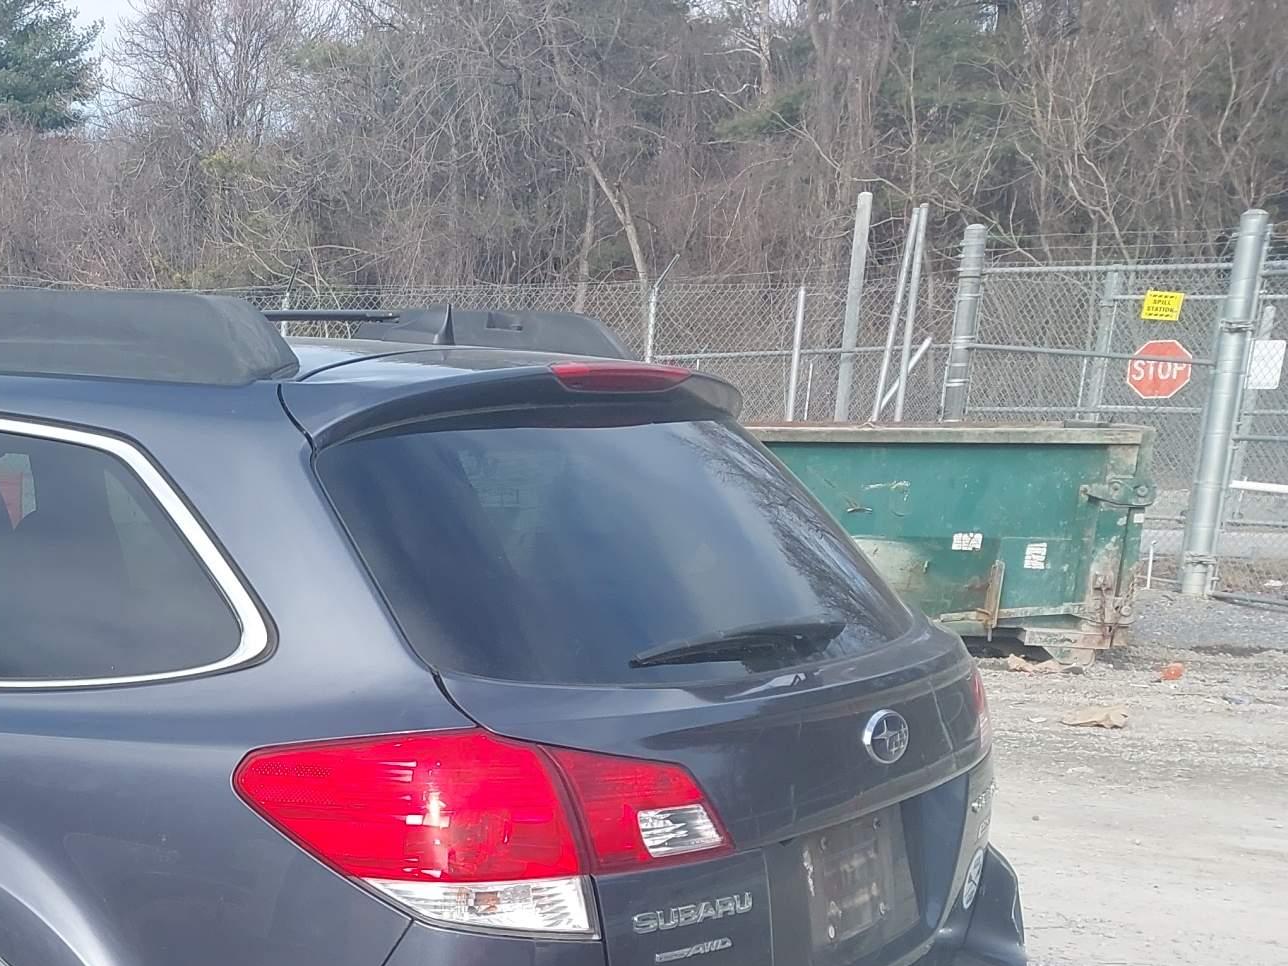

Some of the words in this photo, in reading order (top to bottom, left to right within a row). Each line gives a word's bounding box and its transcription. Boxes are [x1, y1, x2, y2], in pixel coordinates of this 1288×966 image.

[1131, 360, 1187, 381] STOP
[632, 891, 753, 935] SUBARU
[687, 936, 733, 957] AWD
